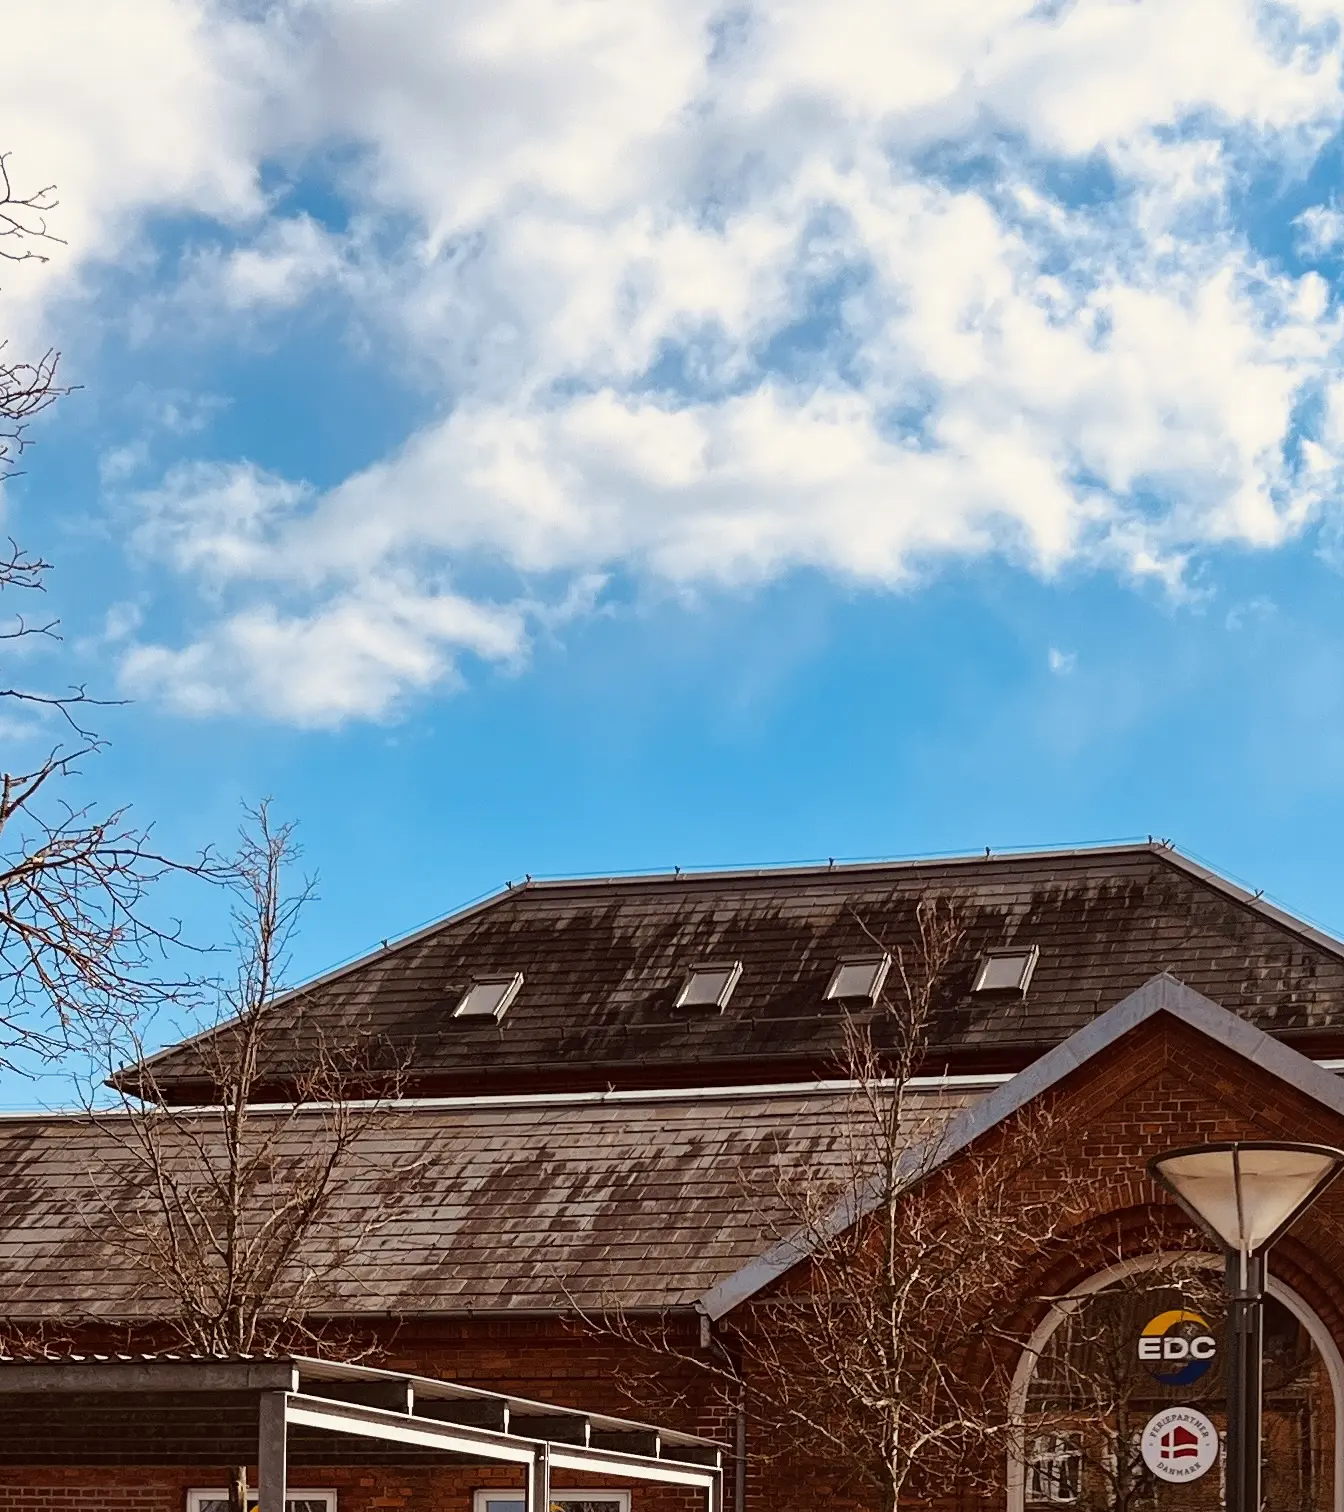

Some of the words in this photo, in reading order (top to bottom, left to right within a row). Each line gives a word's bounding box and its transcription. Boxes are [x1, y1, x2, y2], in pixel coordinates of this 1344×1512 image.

[1138, 1336, 1216, 1360] EDC
[1149, 1414, 1210, 1438] FERIEPARTNER
[1156, 1461, 1202, 1477] DANMARK
